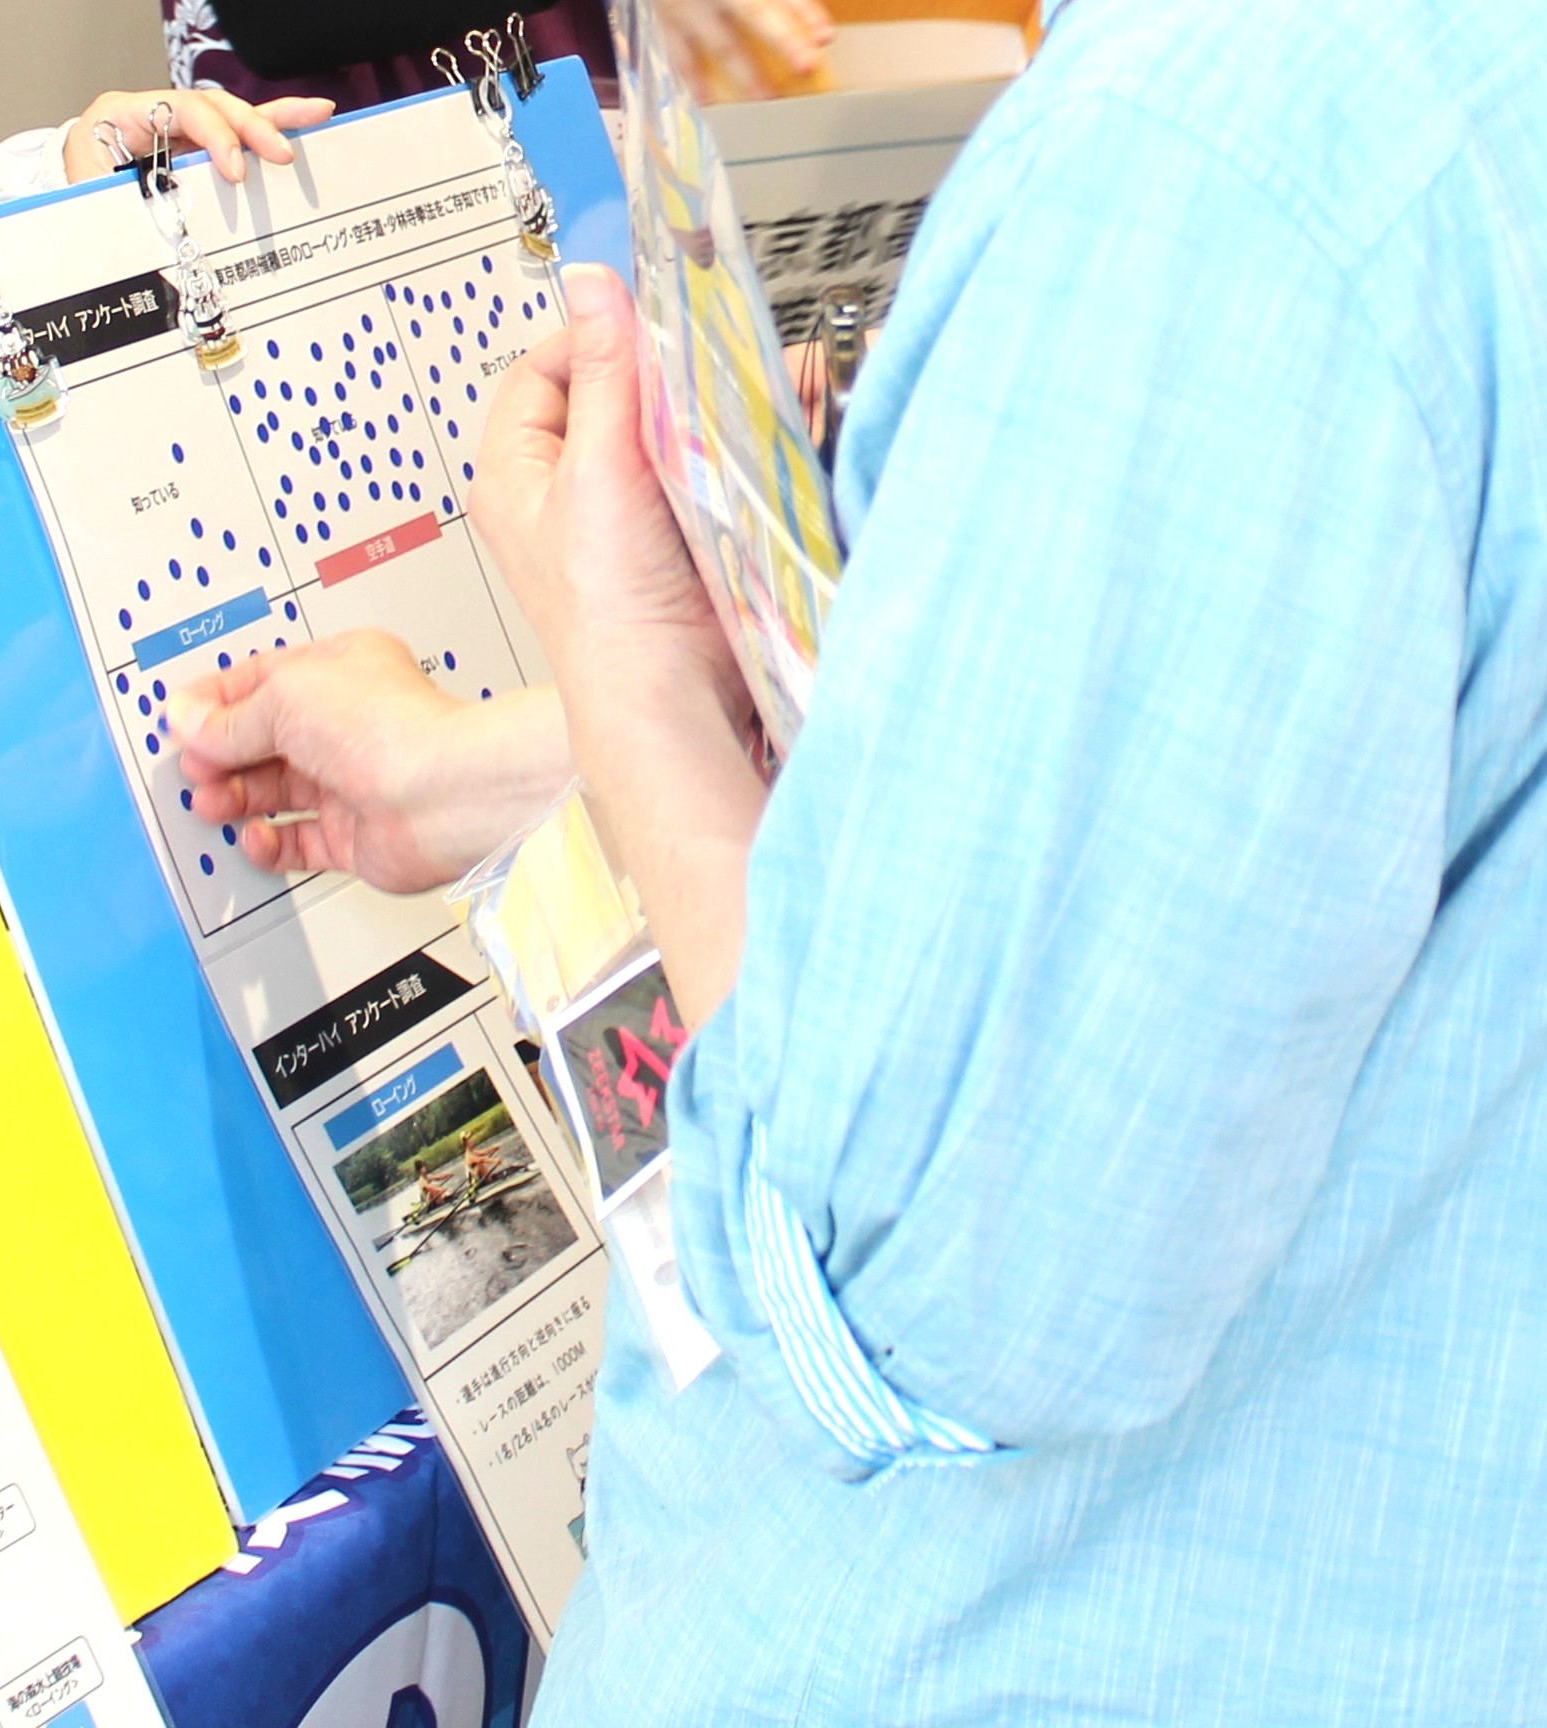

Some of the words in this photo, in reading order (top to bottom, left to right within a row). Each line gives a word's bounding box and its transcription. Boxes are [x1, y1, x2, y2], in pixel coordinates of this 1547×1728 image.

[73, 289, 160, 334] アンケート調査
[131, 482, 181, 516] 知っている
[364, 535, 396, 562] 空手道
[180, 610, 225, 645] ローイング
[274, 1022, 342, 1078] インターハイ
[345, 973, 428, 1036] アンケート調査
[371, 1075, 417, 1118] ローイング
